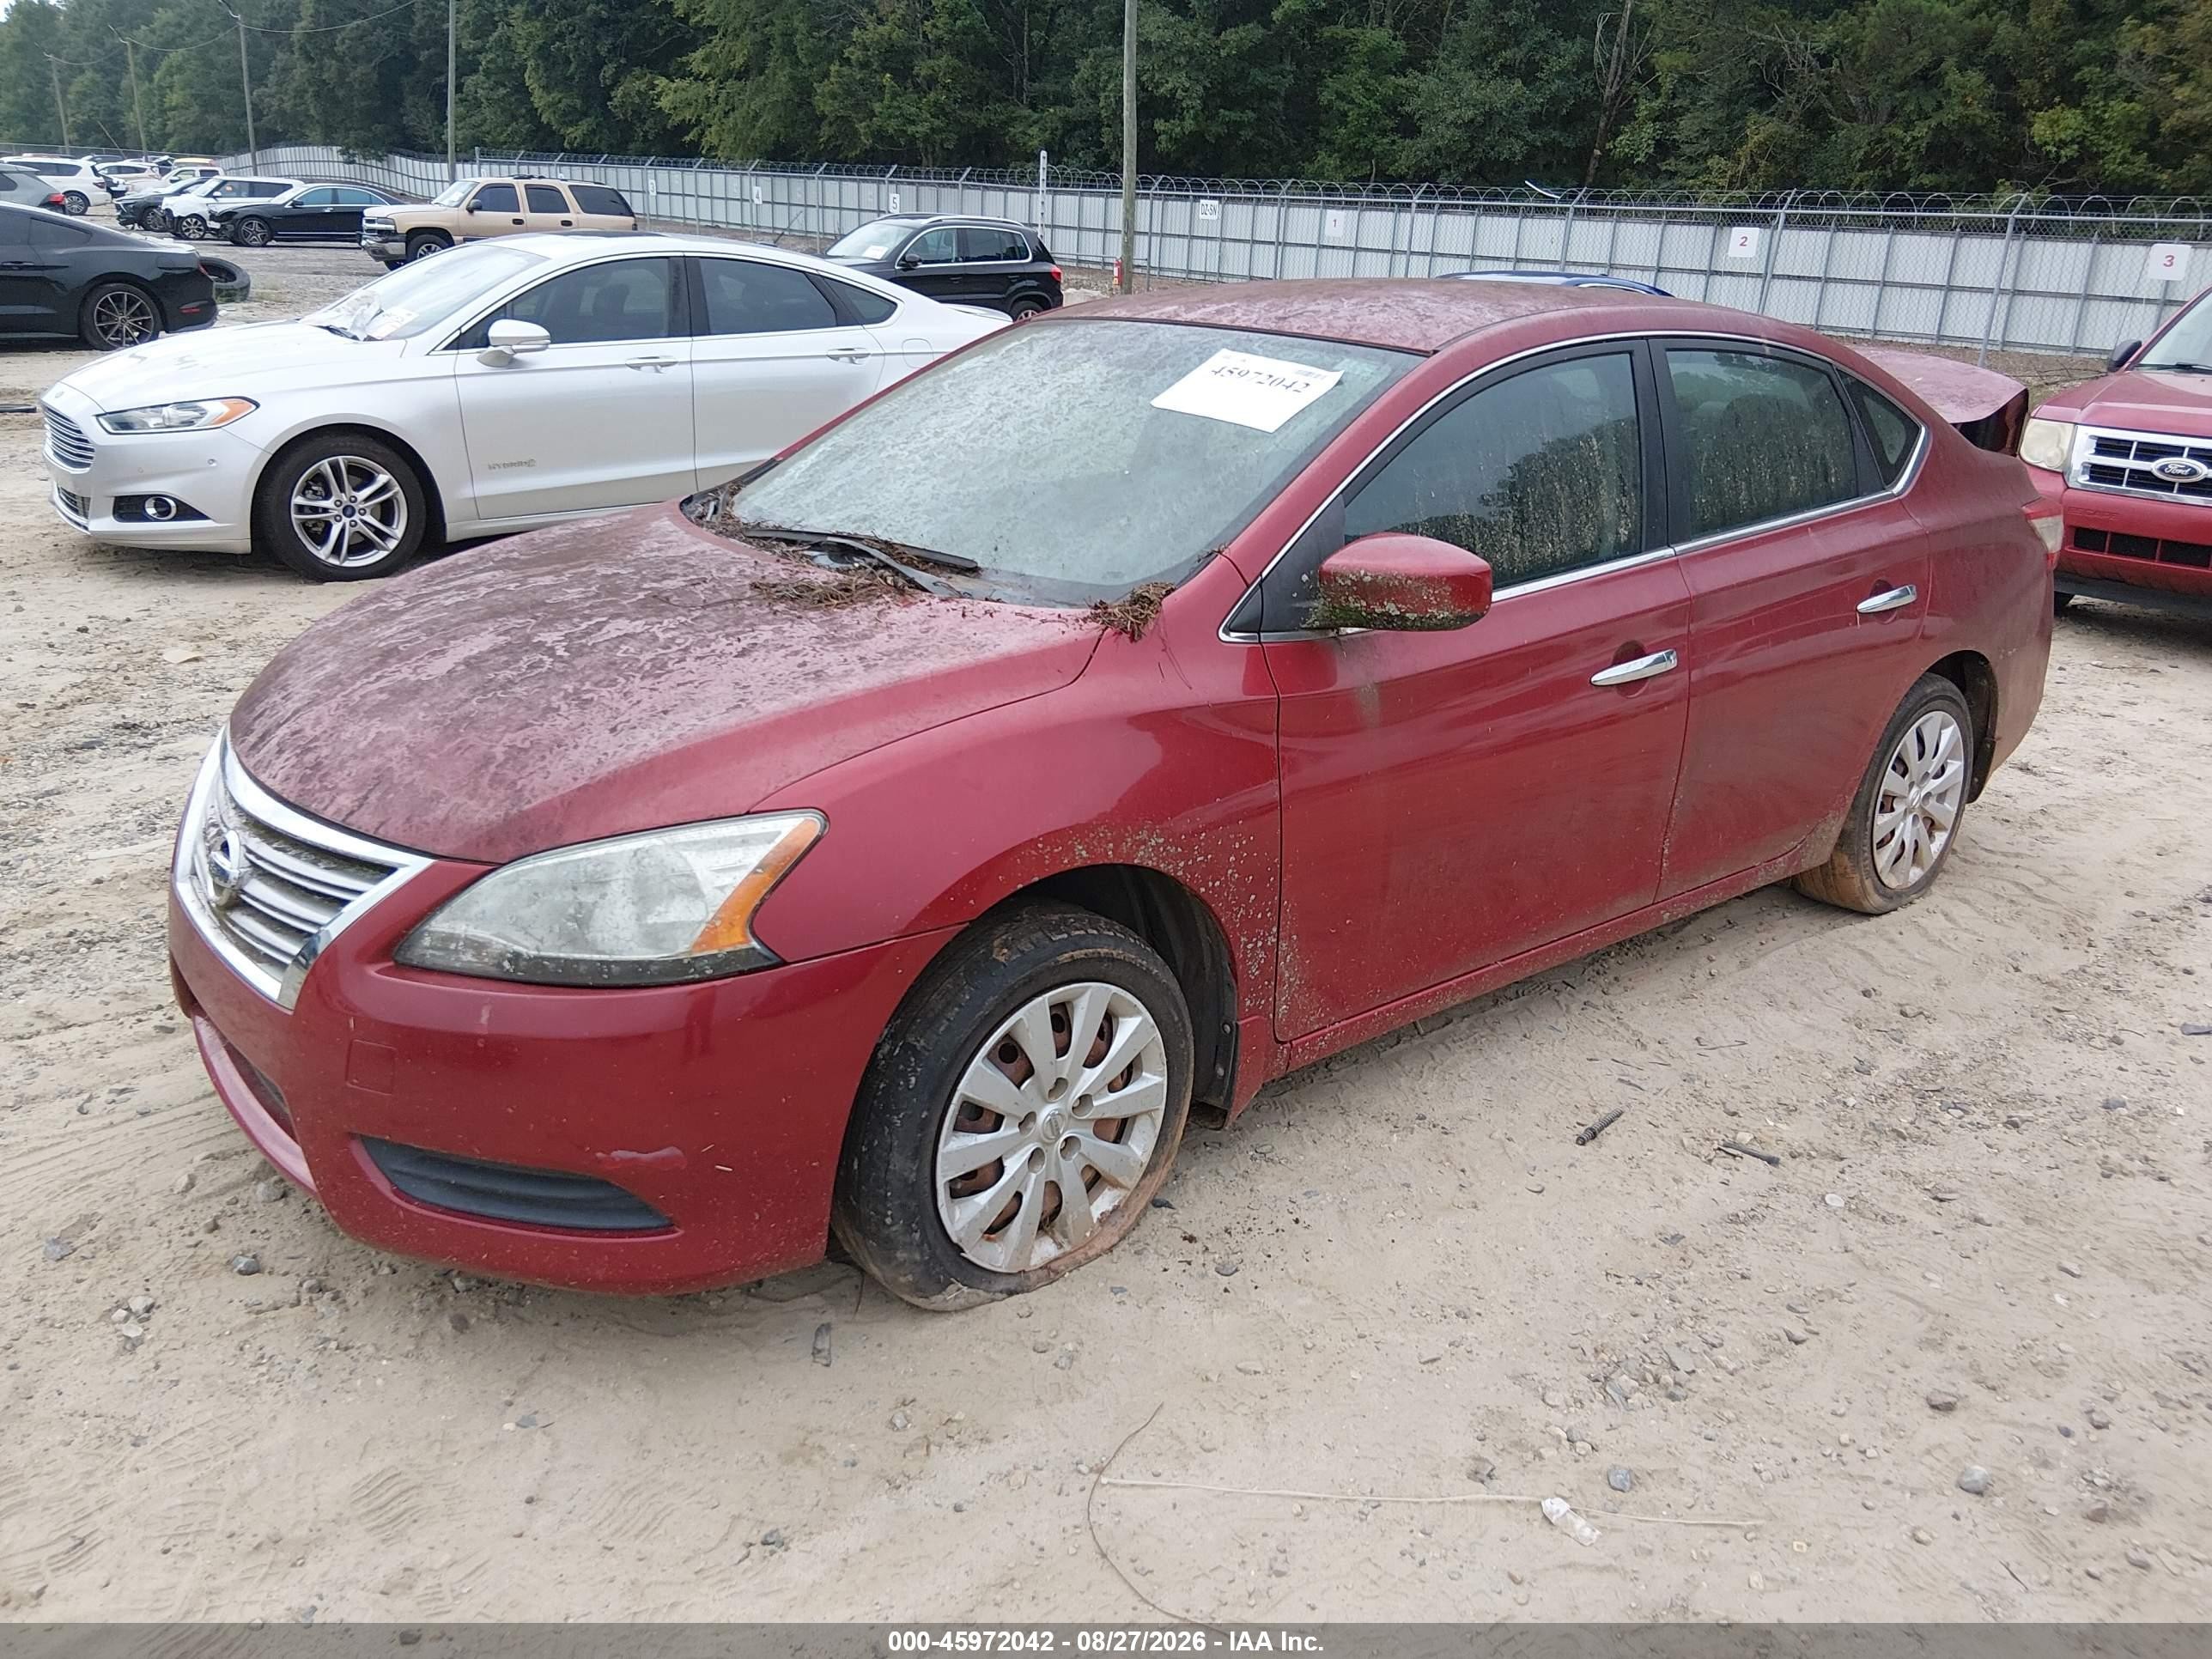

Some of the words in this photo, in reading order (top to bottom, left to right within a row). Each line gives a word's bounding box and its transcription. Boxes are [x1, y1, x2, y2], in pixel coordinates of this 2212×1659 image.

[892, 197, 897, 210] 5
[1200, 203, 1218, 216] DZ-SN
[1739, 235, 1748, 247] 2
[2163, 254, 2175, 268] 3
[1211, 366, 1310, 393] 45972042
[2164, 464, 2192, 476] Ford
